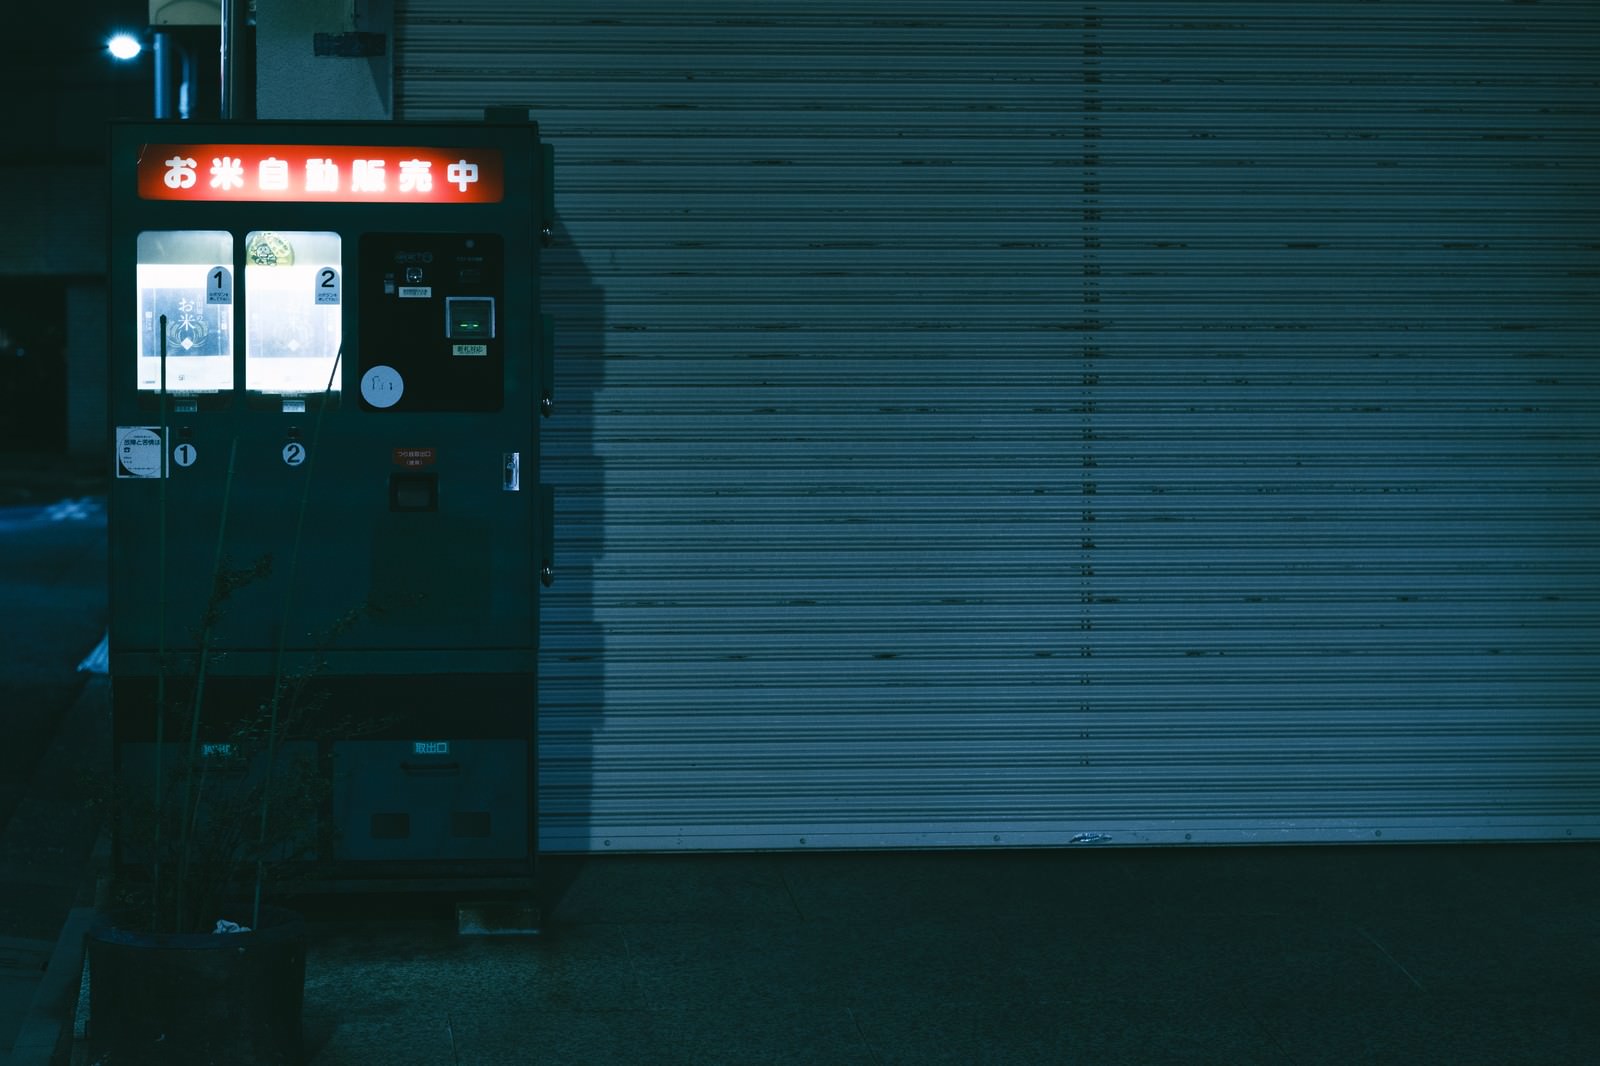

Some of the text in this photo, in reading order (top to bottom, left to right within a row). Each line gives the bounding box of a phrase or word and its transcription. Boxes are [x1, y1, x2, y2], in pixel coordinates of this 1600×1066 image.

[164, 155, 479, 193] お米自動販売中
[214, 271, 222, 288] 1
[321, 270, 335, 287] 2
[178, 297, 196, 331] お米
[180, 445, 188, 464] 1
[287, 444, 300, 463] 2
[415, 742, 447, 754] 取出口
